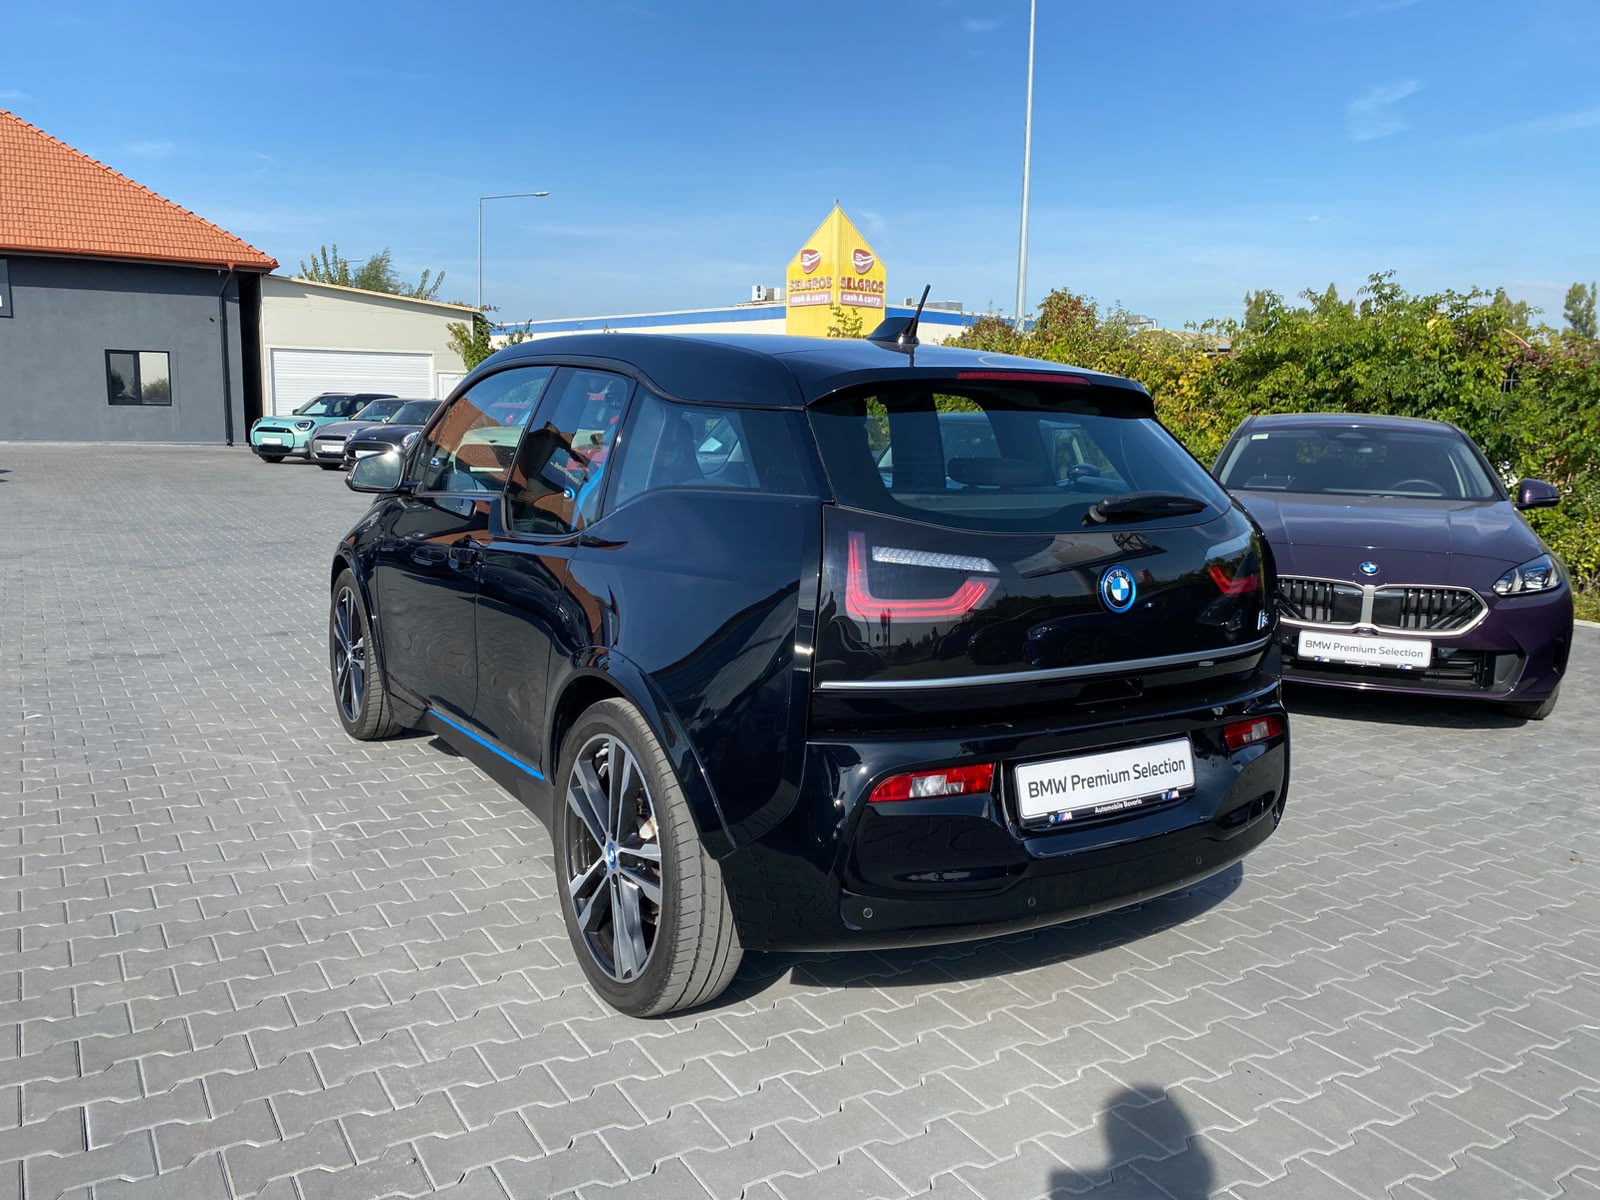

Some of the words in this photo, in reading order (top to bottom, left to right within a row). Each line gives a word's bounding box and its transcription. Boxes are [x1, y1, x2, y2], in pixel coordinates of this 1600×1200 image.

[789, 276, 832, 292] SELGROS
[840, 276, 884, 294] SELGROS
[791, 295, 805, 303] cash
[811, 294, 828, 303] carry
[843, 294, 858, 302] cash
[864, 295, 881, 306] carry
[1305, 639, 1332, 650] BMW
[1333, 642, 1376, 654] Premium
[1378, 646, 1424, 658] Selection
[1028, 776, 1068, 799] BMW
[1071, 769, 1131, 791] Premium
[1132, 758, 1186, 780] Selection
[1094, 803, 1123, 814] Automobile
